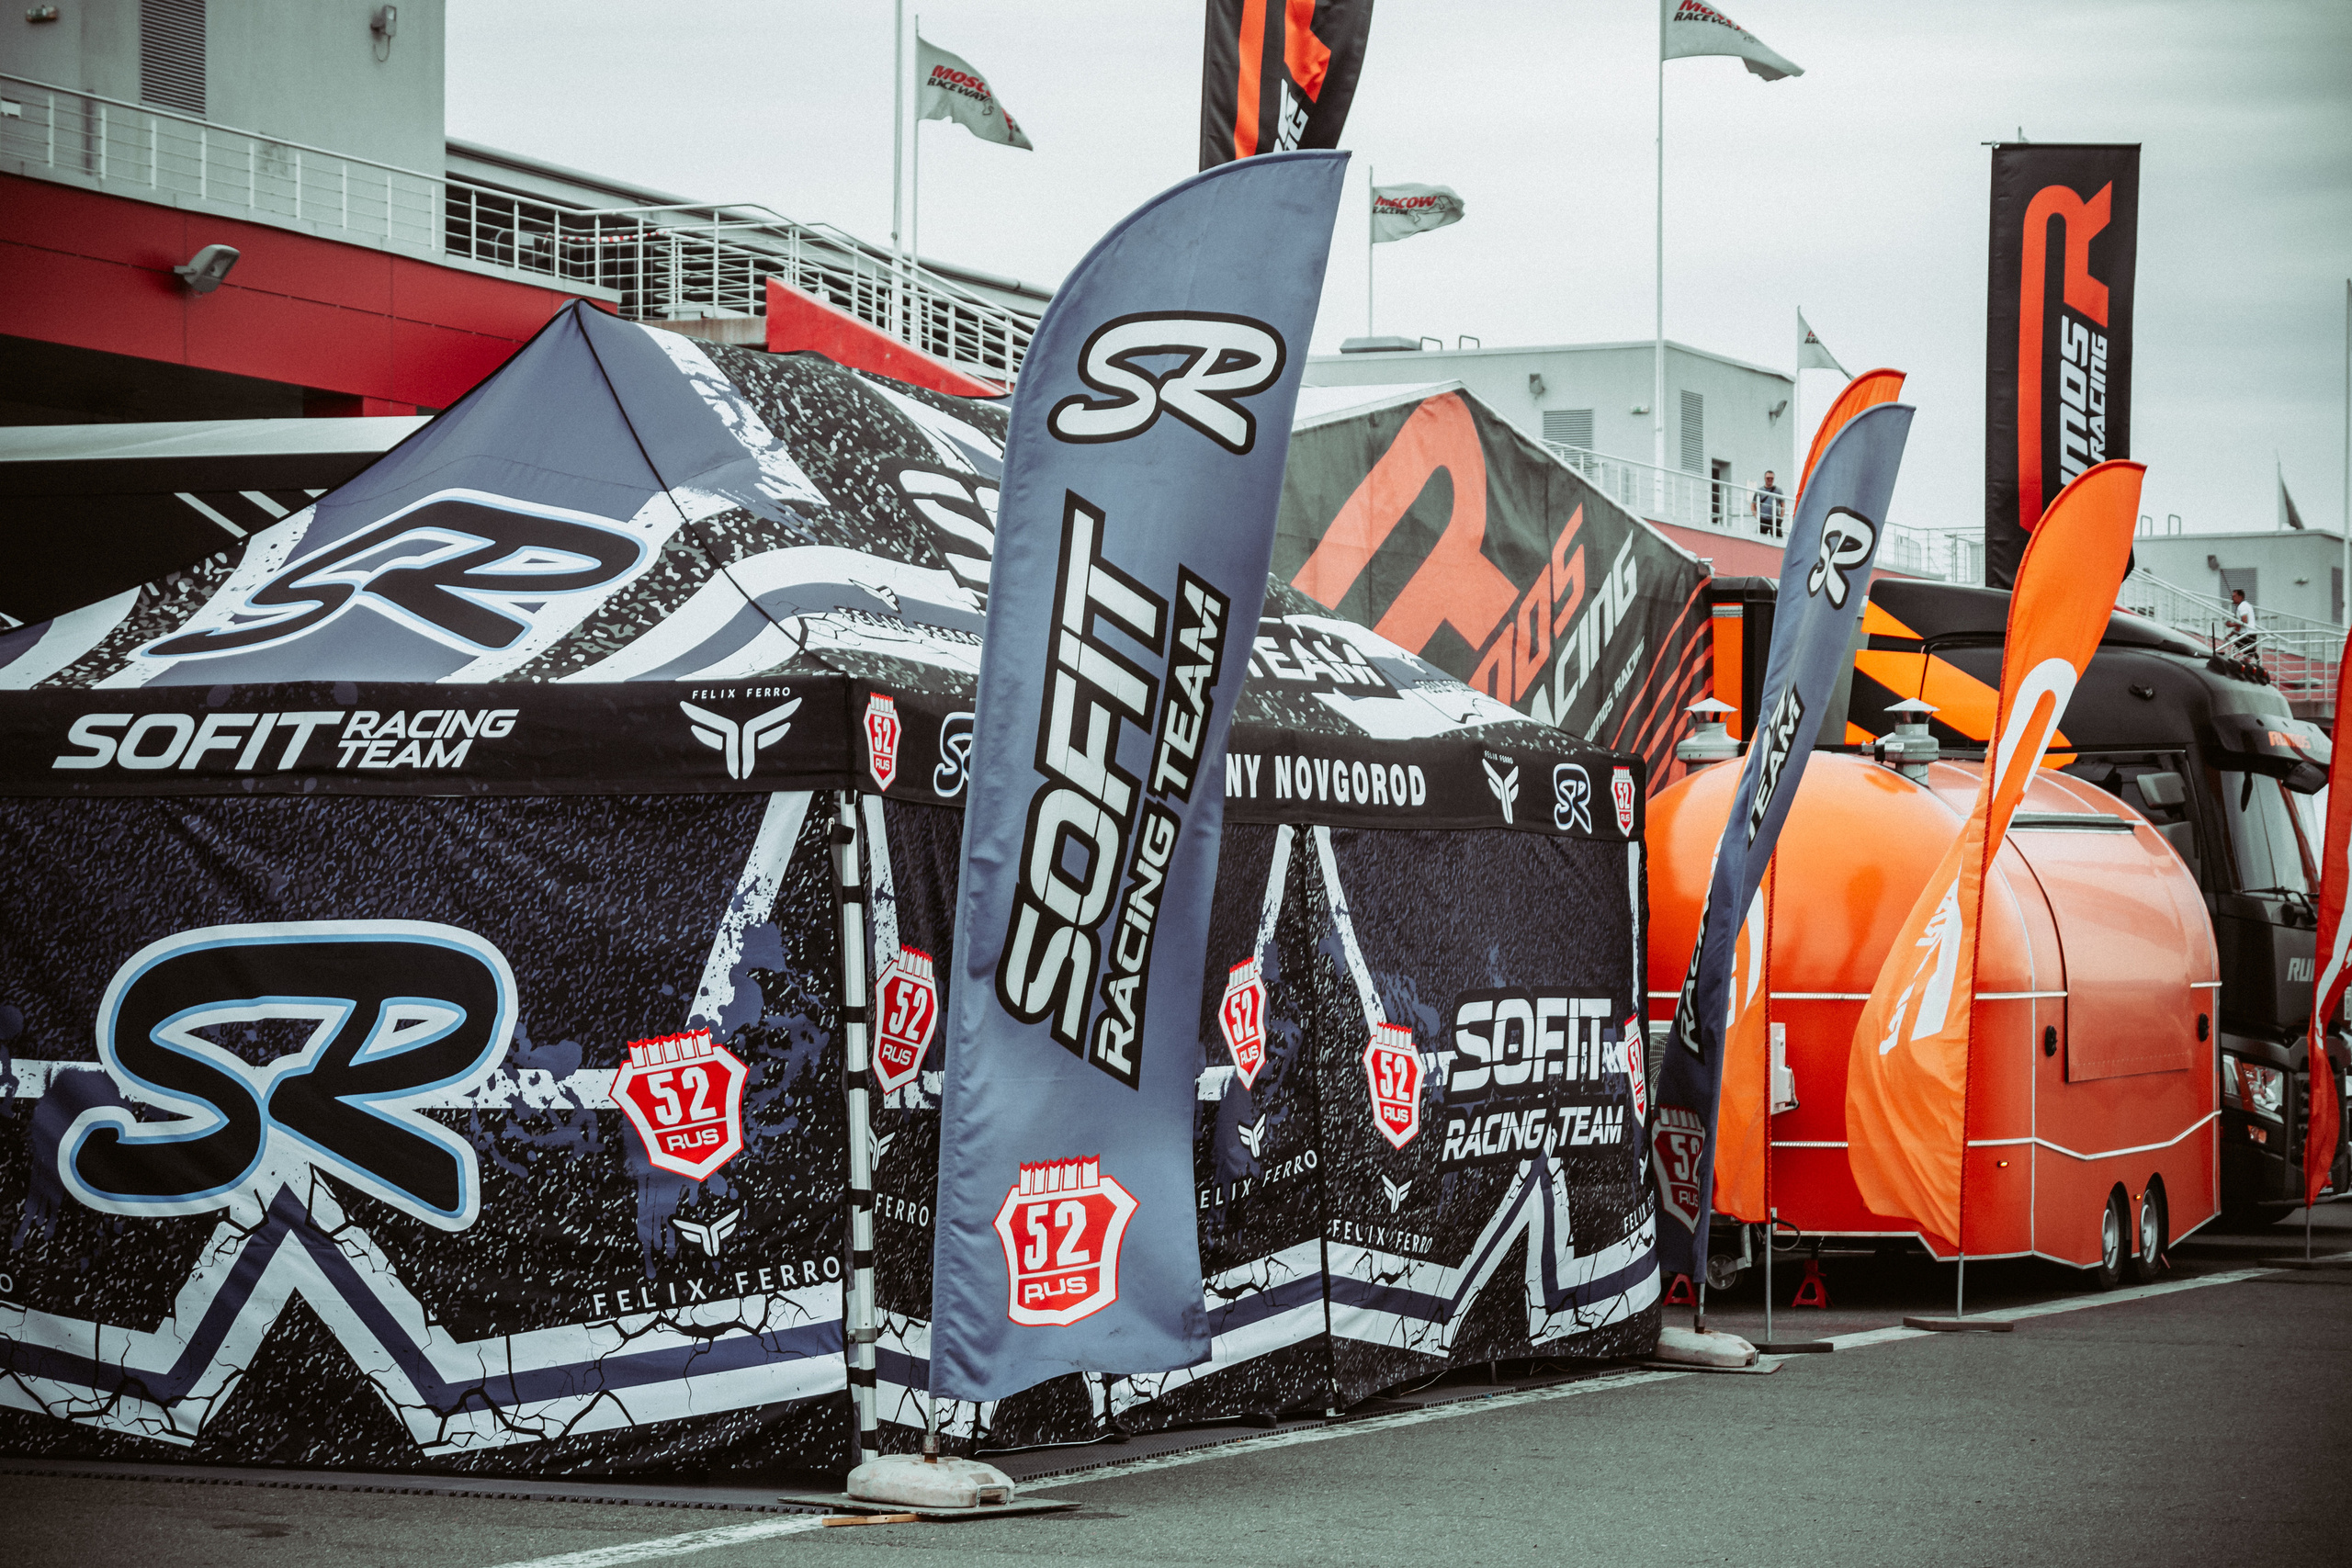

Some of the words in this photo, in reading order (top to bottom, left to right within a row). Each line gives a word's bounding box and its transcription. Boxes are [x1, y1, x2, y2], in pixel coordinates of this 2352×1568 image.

[1047, 310, 1286, 456] SR
[2089, 332, 2108, 463] RACING
[126, 487, 649, 660] SR
[692, 688, 736, 700] FELIX
[746, 686, 791, 698] FERRO
[51, 711, 350, 771] SOFIT
[342, 708, 520, 739] RACING
[337, 739, 473, 770] TEAM
[874, 720, 892, 755] 52
[875, 756, 890, 772] RUS
[1005, 508, 1159, 1042] SOFIT
[1274, 755, 1426, 807] NOVGOROD
[1617, 782, 1631, 810] 52
[1620, 812, 1631, 822] RUS
[1097, 813, 1176, 1077] RACING
[1153, 579, 1223, 798] TEAM
[888, 980, 928, 1043] 52
[1231, 996, 1257, 1041] 52
[880, 1043, 913, 1066] RUS
[1239, 1043, 1260, 1066] RUS
[1451, 998, 1611, 1092] SOFIT
[1629, 1039, 1644, 1087] 52
[56, 919, 520, 1233] SR
[648, 1068, 718, 1128] 52
[1379, 1055, 1412, 1102] 52
[1383, 1105, 1409, 1124] RUS
[1442, 1108, 1547, 1162] RACING
[1558, 1105, 1624, 1146] TEAM
[666, 1126, 720, 1152] RUS
[1669, 1134, 1701, 1186] 52
[1199, 1176, 1253, 1209] ELIX
[1261, 1148, 1317, 1188] FERRO
[1679, 1190, 1700, 1208] RUS
[875, 1192, 930, 1227] FERRO
[1623, 1202, 1647, 1235] FELIX
[1023, 1199, 1091, 1271] 52
[1332, 1219, 1385, 1247] FELIX
[1395, 1230, 1434, 1255] FERRO
[593, 1277, 709, 1316] FELIX
[735, 1255, 841, 1293] FERRO
[1023, 1274, 1089, 1305] RUS
